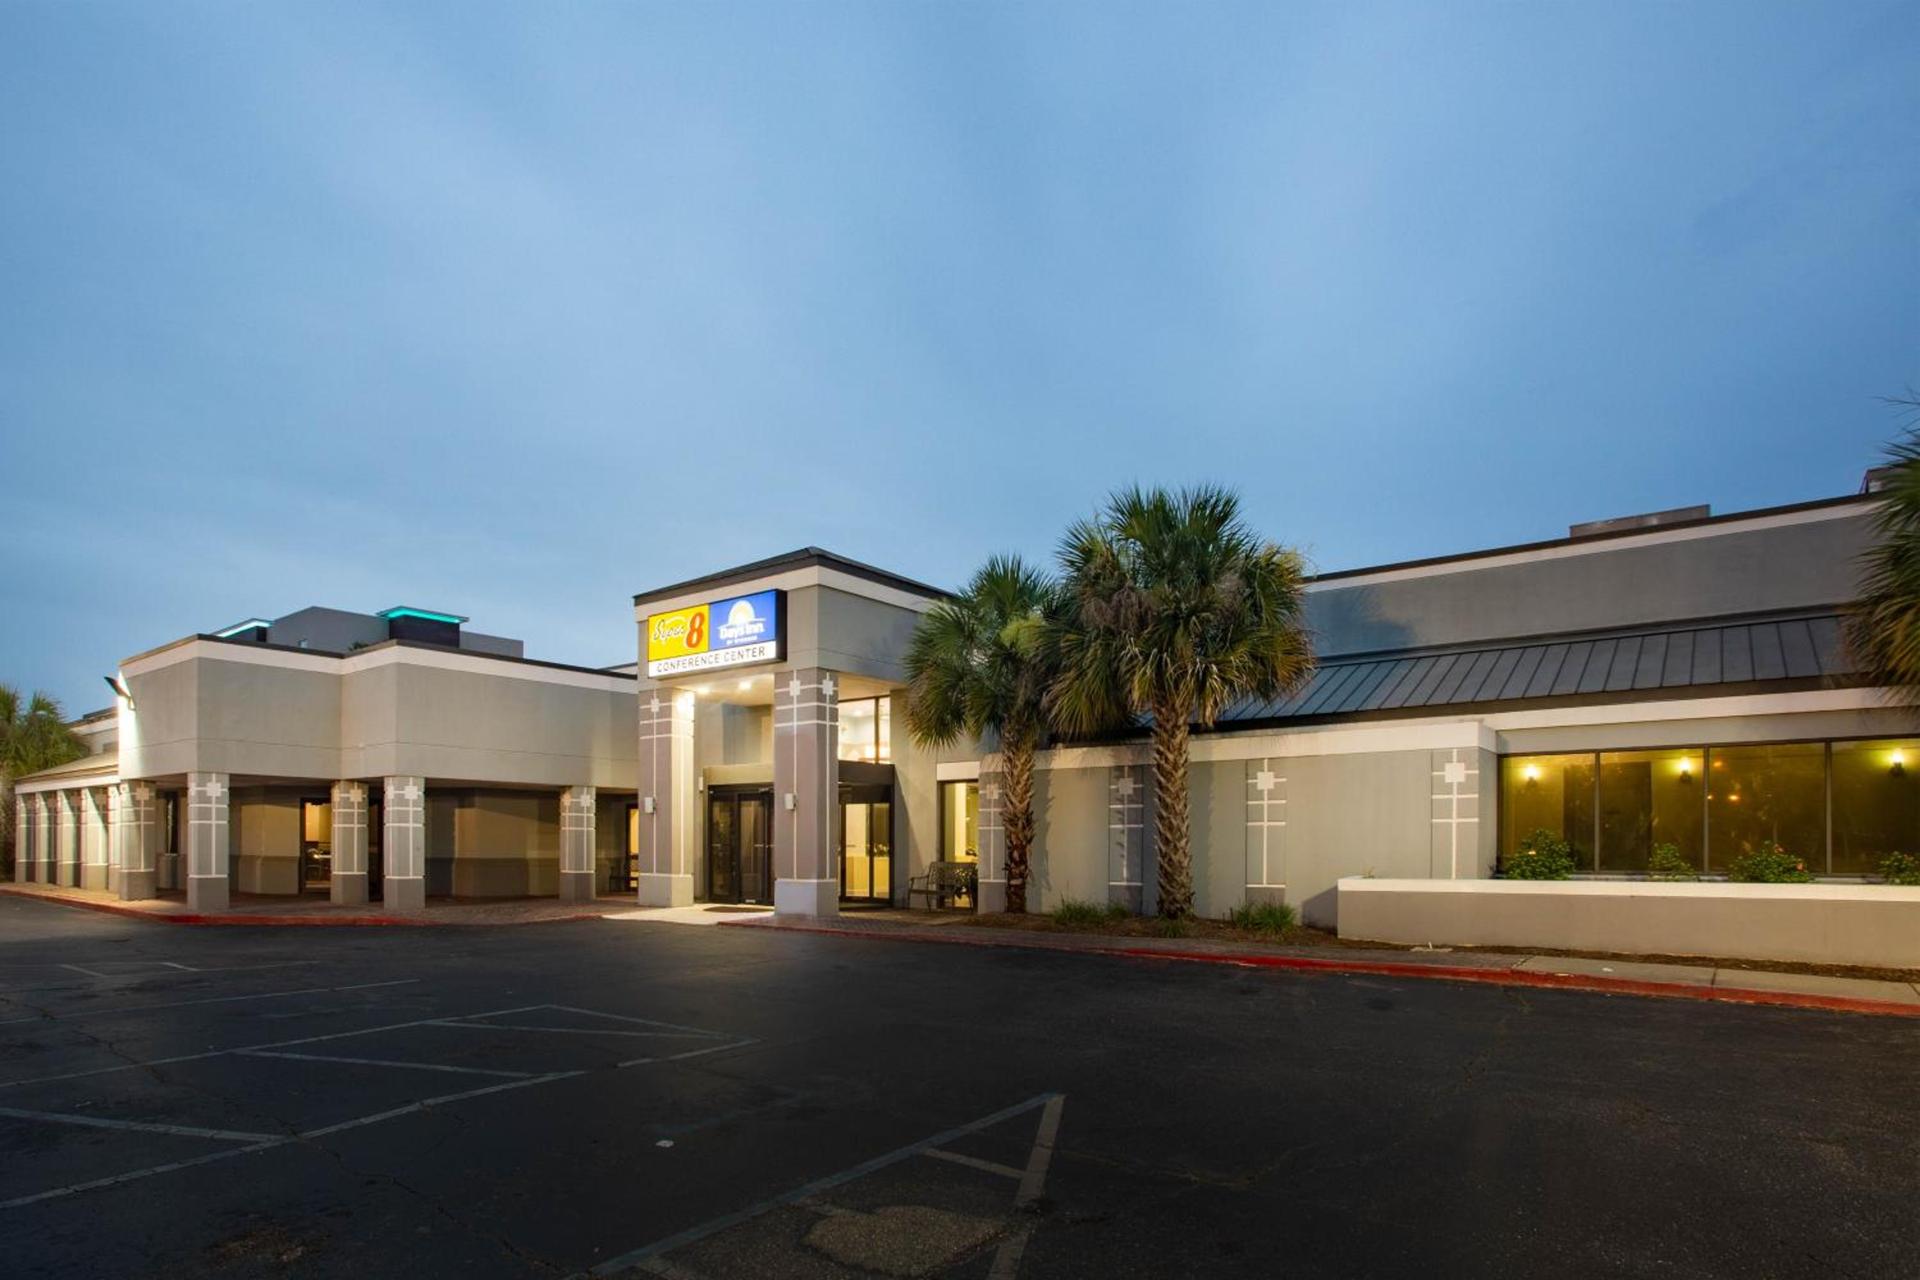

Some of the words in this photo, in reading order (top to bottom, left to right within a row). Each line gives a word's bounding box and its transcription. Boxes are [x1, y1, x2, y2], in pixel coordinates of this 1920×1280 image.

[653, 618, 686, 645] Super
[686, 611, 705, 648] 8
[656, 653, 720, 673] CONFERENCE
[723, 646, 766, 662] CENTER
